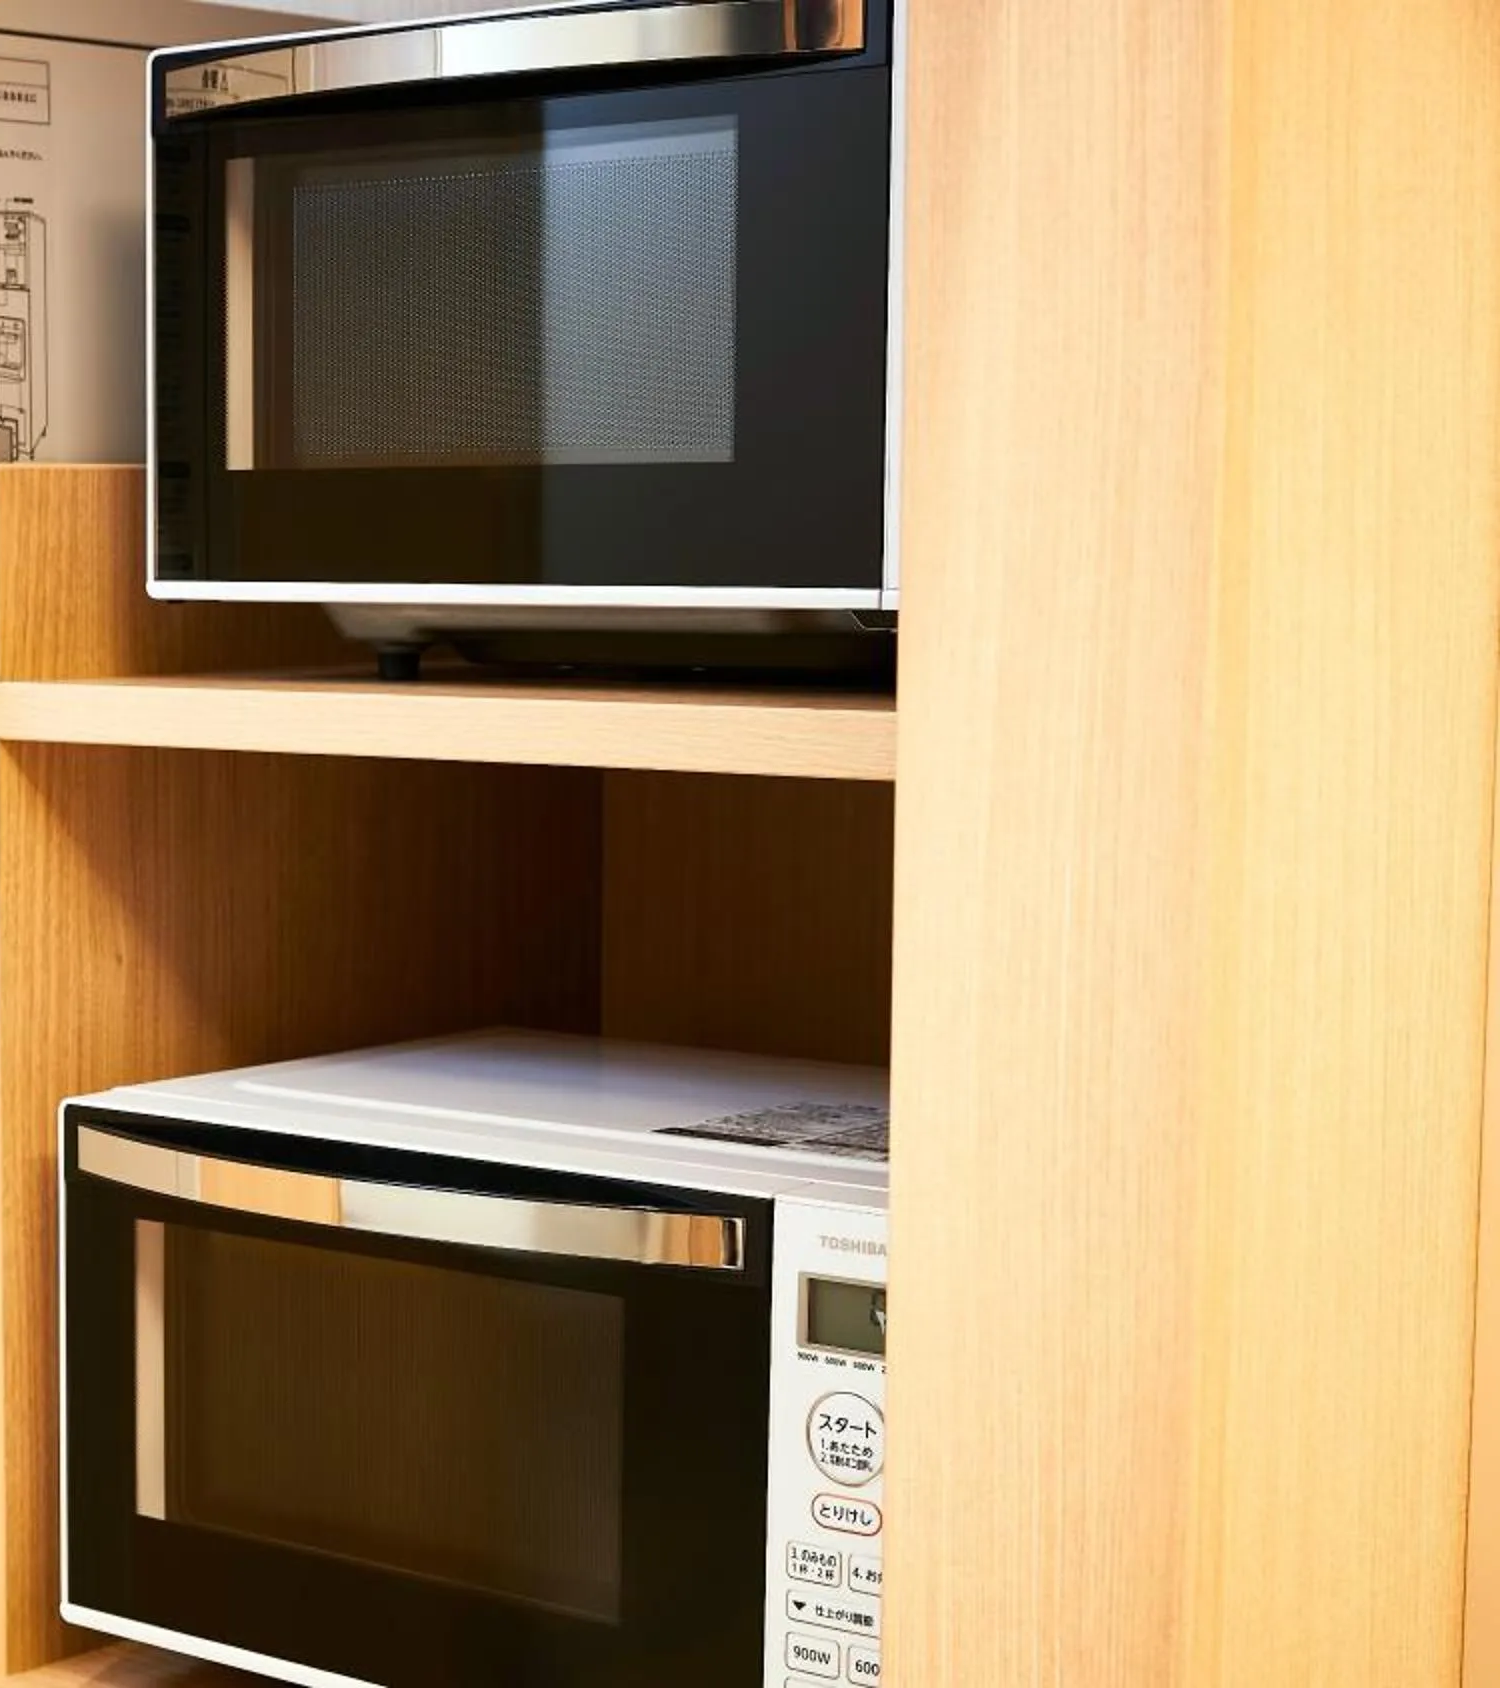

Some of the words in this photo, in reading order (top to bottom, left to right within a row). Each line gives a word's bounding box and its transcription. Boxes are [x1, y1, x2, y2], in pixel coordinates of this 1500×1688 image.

[819, 1235, 887, 1257] TOSHIBA
[819, 1413, 877, 1439] スタート
[819, 1503, 873, 1527] とりけし
[793, 1645, 831, 1665] 900W
